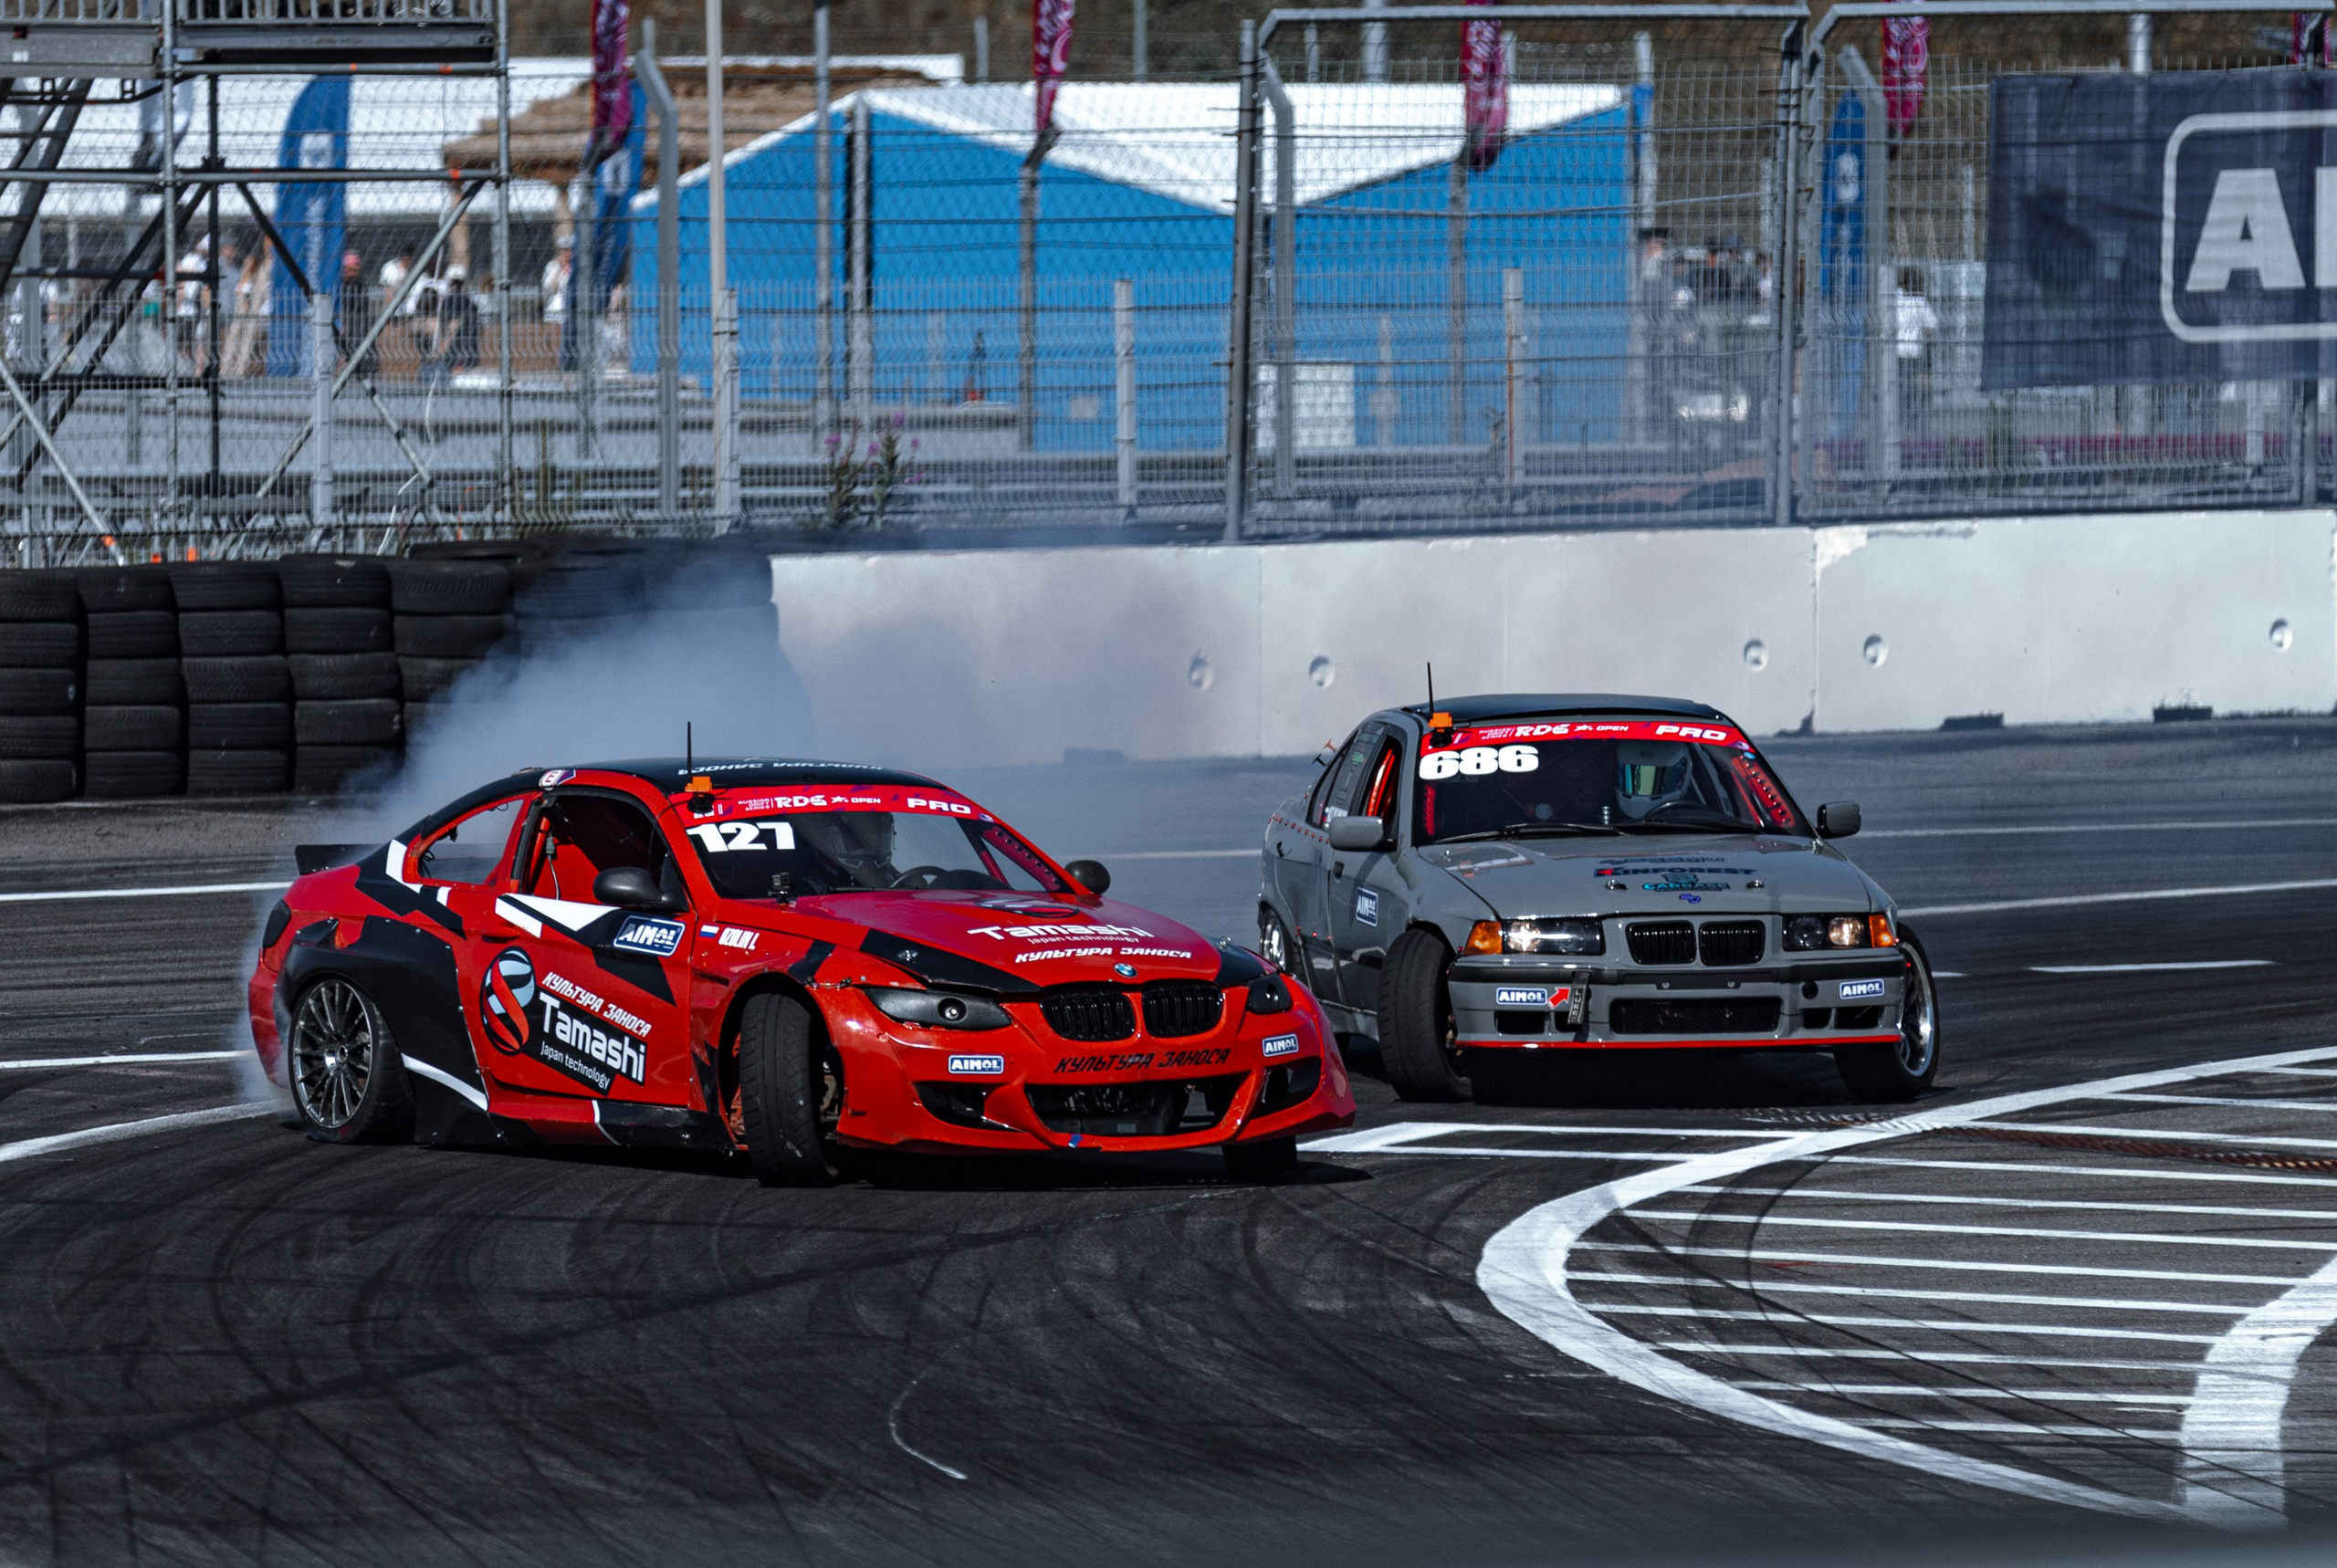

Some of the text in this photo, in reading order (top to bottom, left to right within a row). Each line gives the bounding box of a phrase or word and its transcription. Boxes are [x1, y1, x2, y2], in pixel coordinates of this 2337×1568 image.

[1655, 725, 1727, 741] PRO
[1419, 744, 1539, 780] 686
[774, 795, 828, 809] RDS
[907, 798, 971, 814] PRO
[686, 821, 796, 852] 127
[618, 923, 676, 946] AIMOL
[967, 924, 1155, 941] Tamashi
[1065, 935, 1140, 944] technology
[1015, 947, 1192, 964] КУЛЬТУРА ЗАНОСА
[1498, 991, 1545, 1002] AIMOL
[1842, 983, 1882, 997] AIMOL
[541, 971, 653, 1038] КУЛЬТУРА ЗАНОСА
[539, 991, 647, 1083] Tamashi
[1265, 1038, 1297, 1054] AIMOL
[951, 1059, 1001, 1071] AIMOL
[1053, 1048, 1231, 1074] КУЛЬТУРА ЗАНОСА
[565, 1053, 611, 1091] technology
